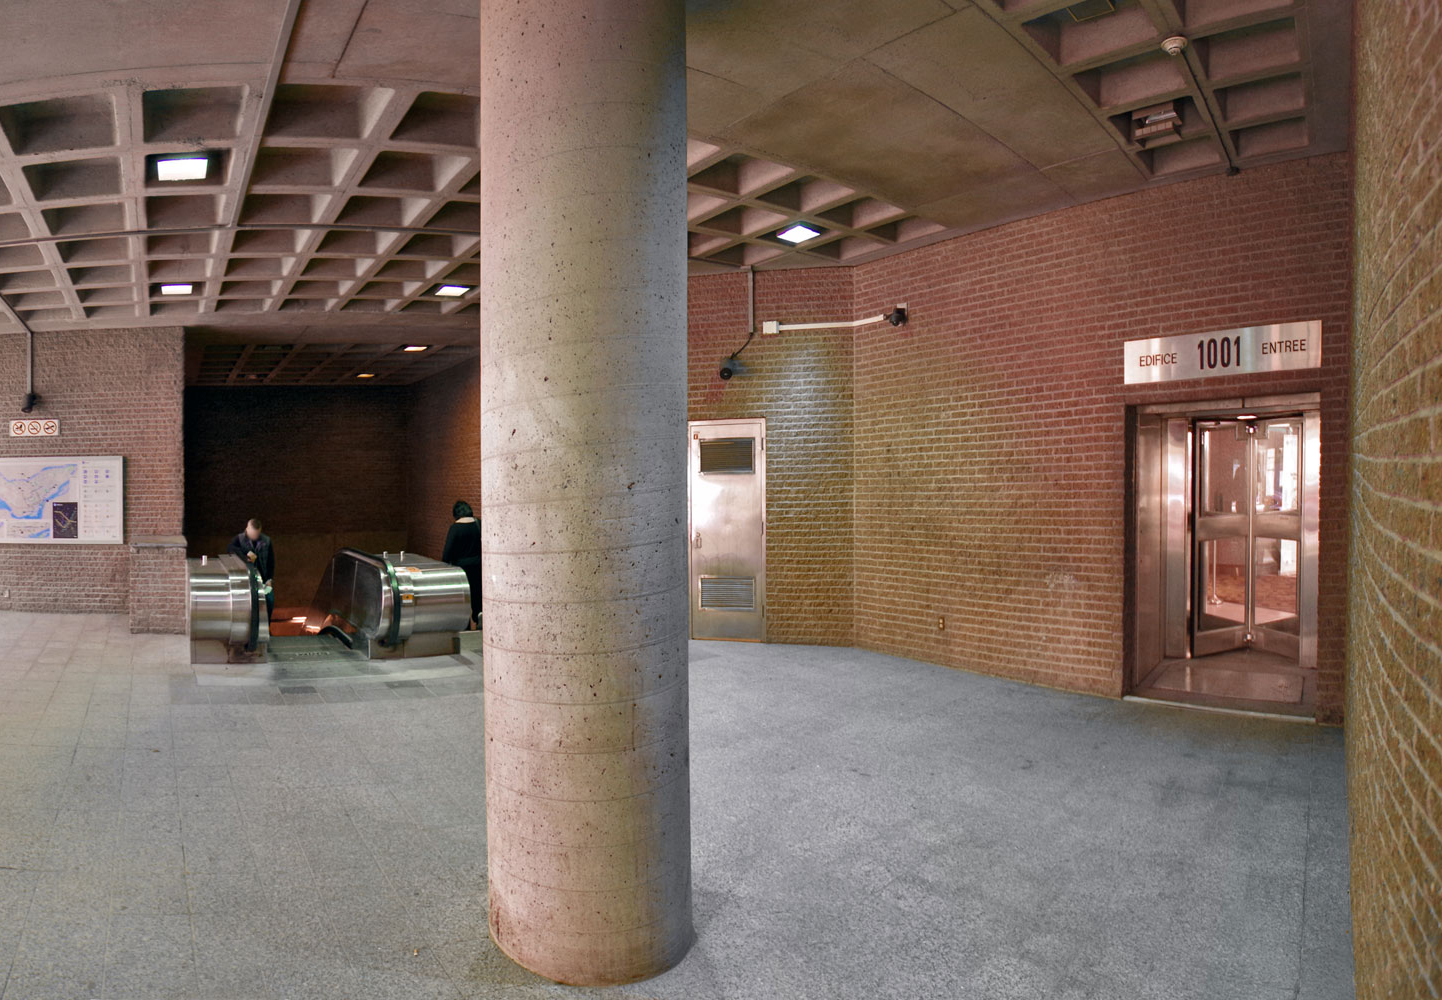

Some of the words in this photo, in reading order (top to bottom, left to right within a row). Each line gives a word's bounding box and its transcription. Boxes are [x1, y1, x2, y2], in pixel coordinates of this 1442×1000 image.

[1139, 353, 1178, 367] EDIFICE
[1197, 335, 1241, 370] 1001
[1261, 339, 1307, 355] ENTREE
